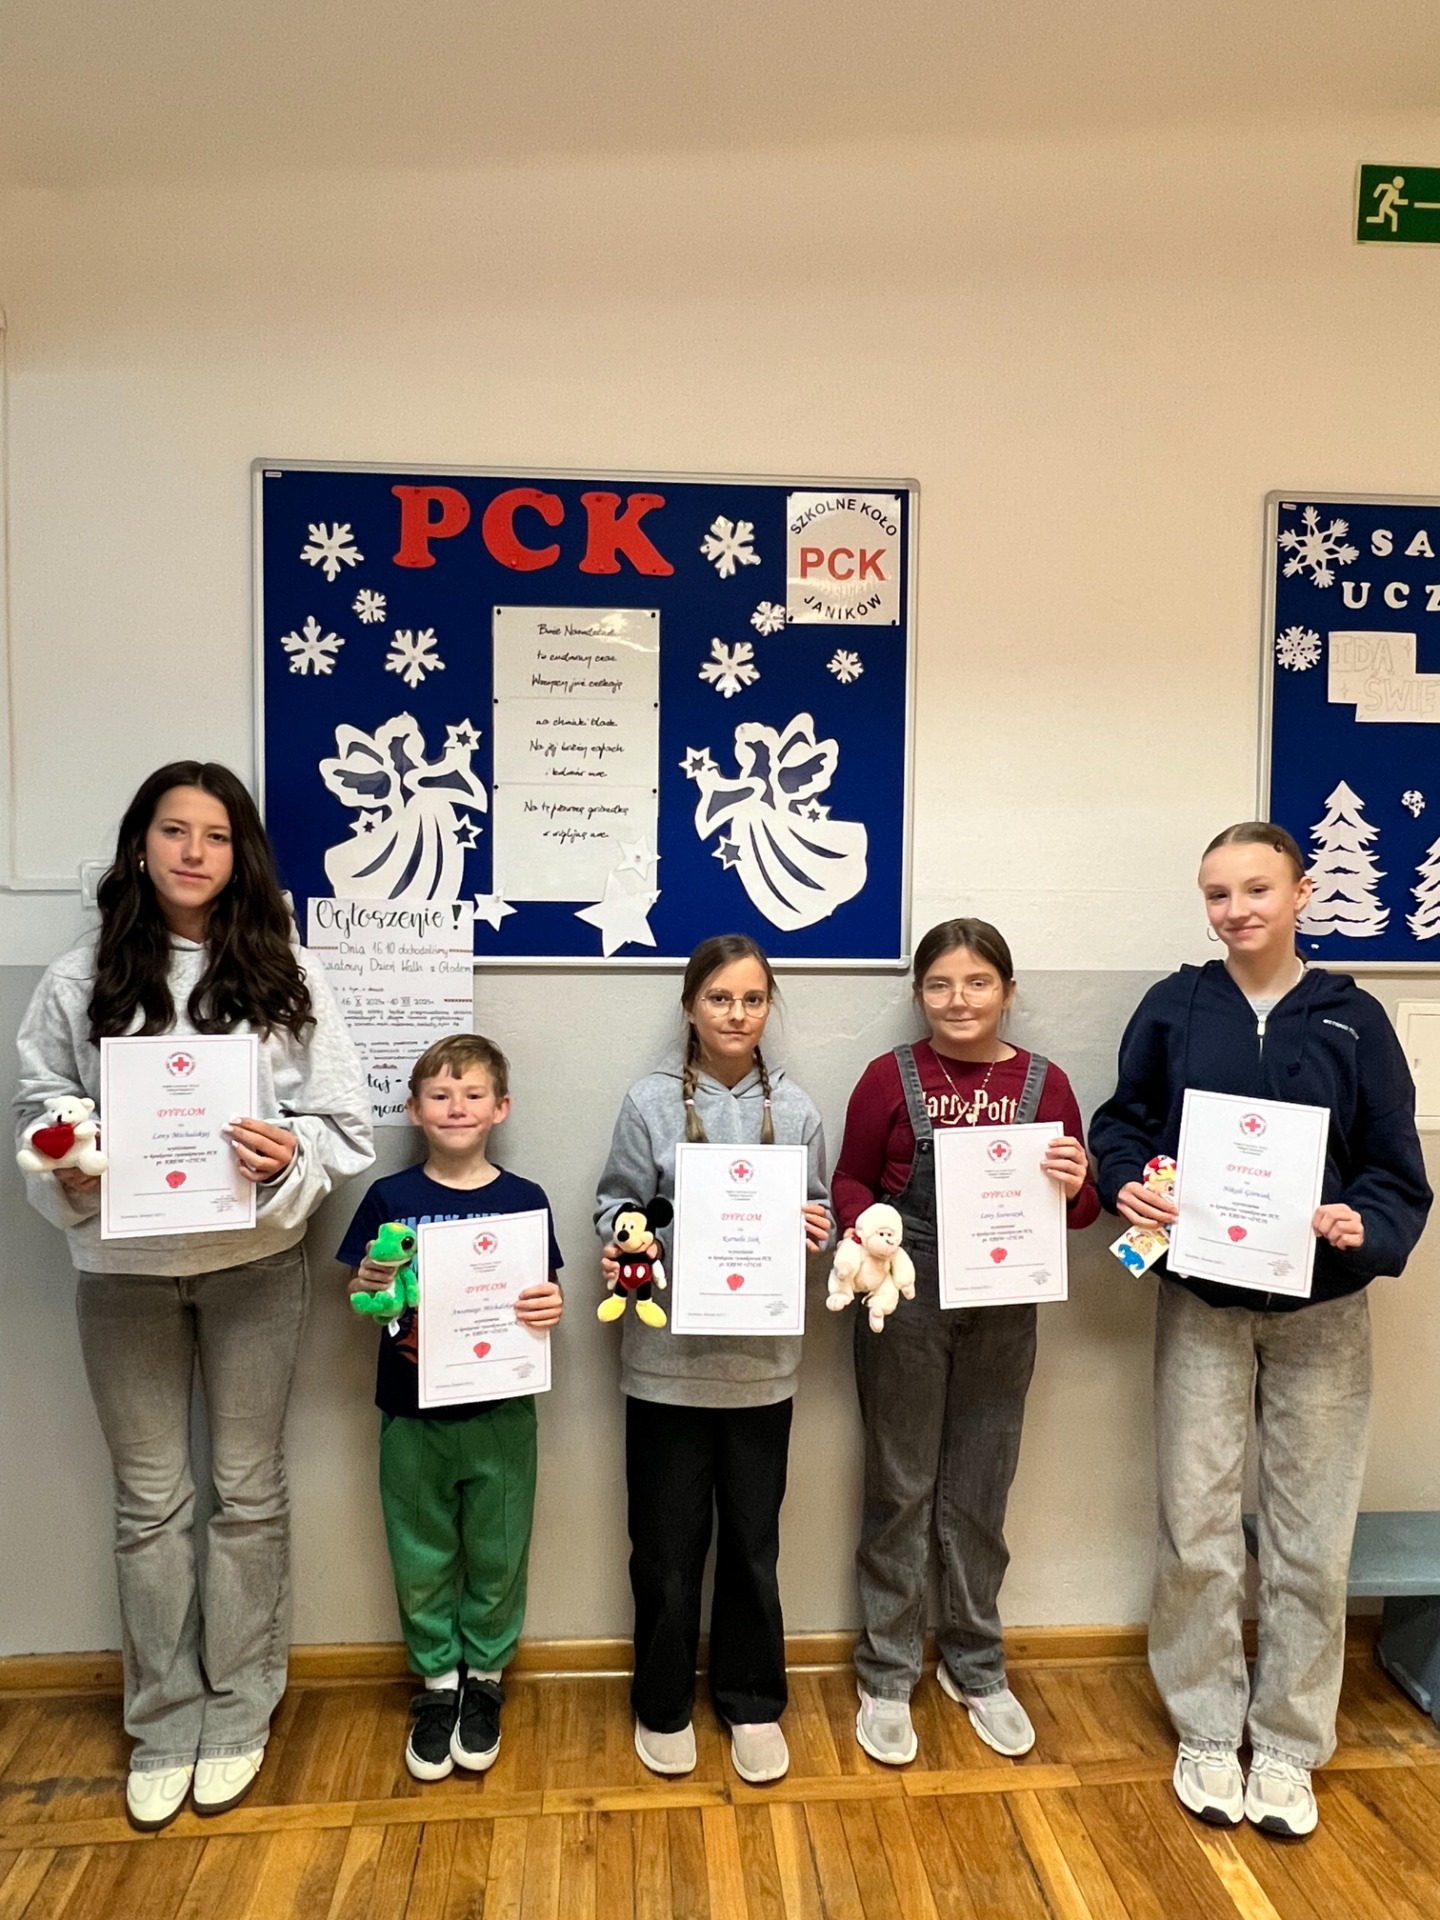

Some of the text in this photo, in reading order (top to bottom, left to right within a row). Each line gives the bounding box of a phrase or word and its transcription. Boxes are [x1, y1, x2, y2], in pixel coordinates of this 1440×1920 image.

[790, 498, 897, 536] SZKOLNE KOŁO
[392, 485, 675, 576] PCK
[800, 547, 887, 581] PCK
[804, 594, 882, 620] JANIKÓW
[316, 900, 446, 939] Ogłoszenie
[157, 1107, 206, 1118] DYPLOM
[922, 1091, 970, 1125] arry
[1226, 1164, 1272, 1178] DYPLOM
[981, 1190, 1021, 1199] DYPLOM
[721, 1213, 762, 1222] DYPLOM
[466, 1282, 507, 1294] DYPLOM
